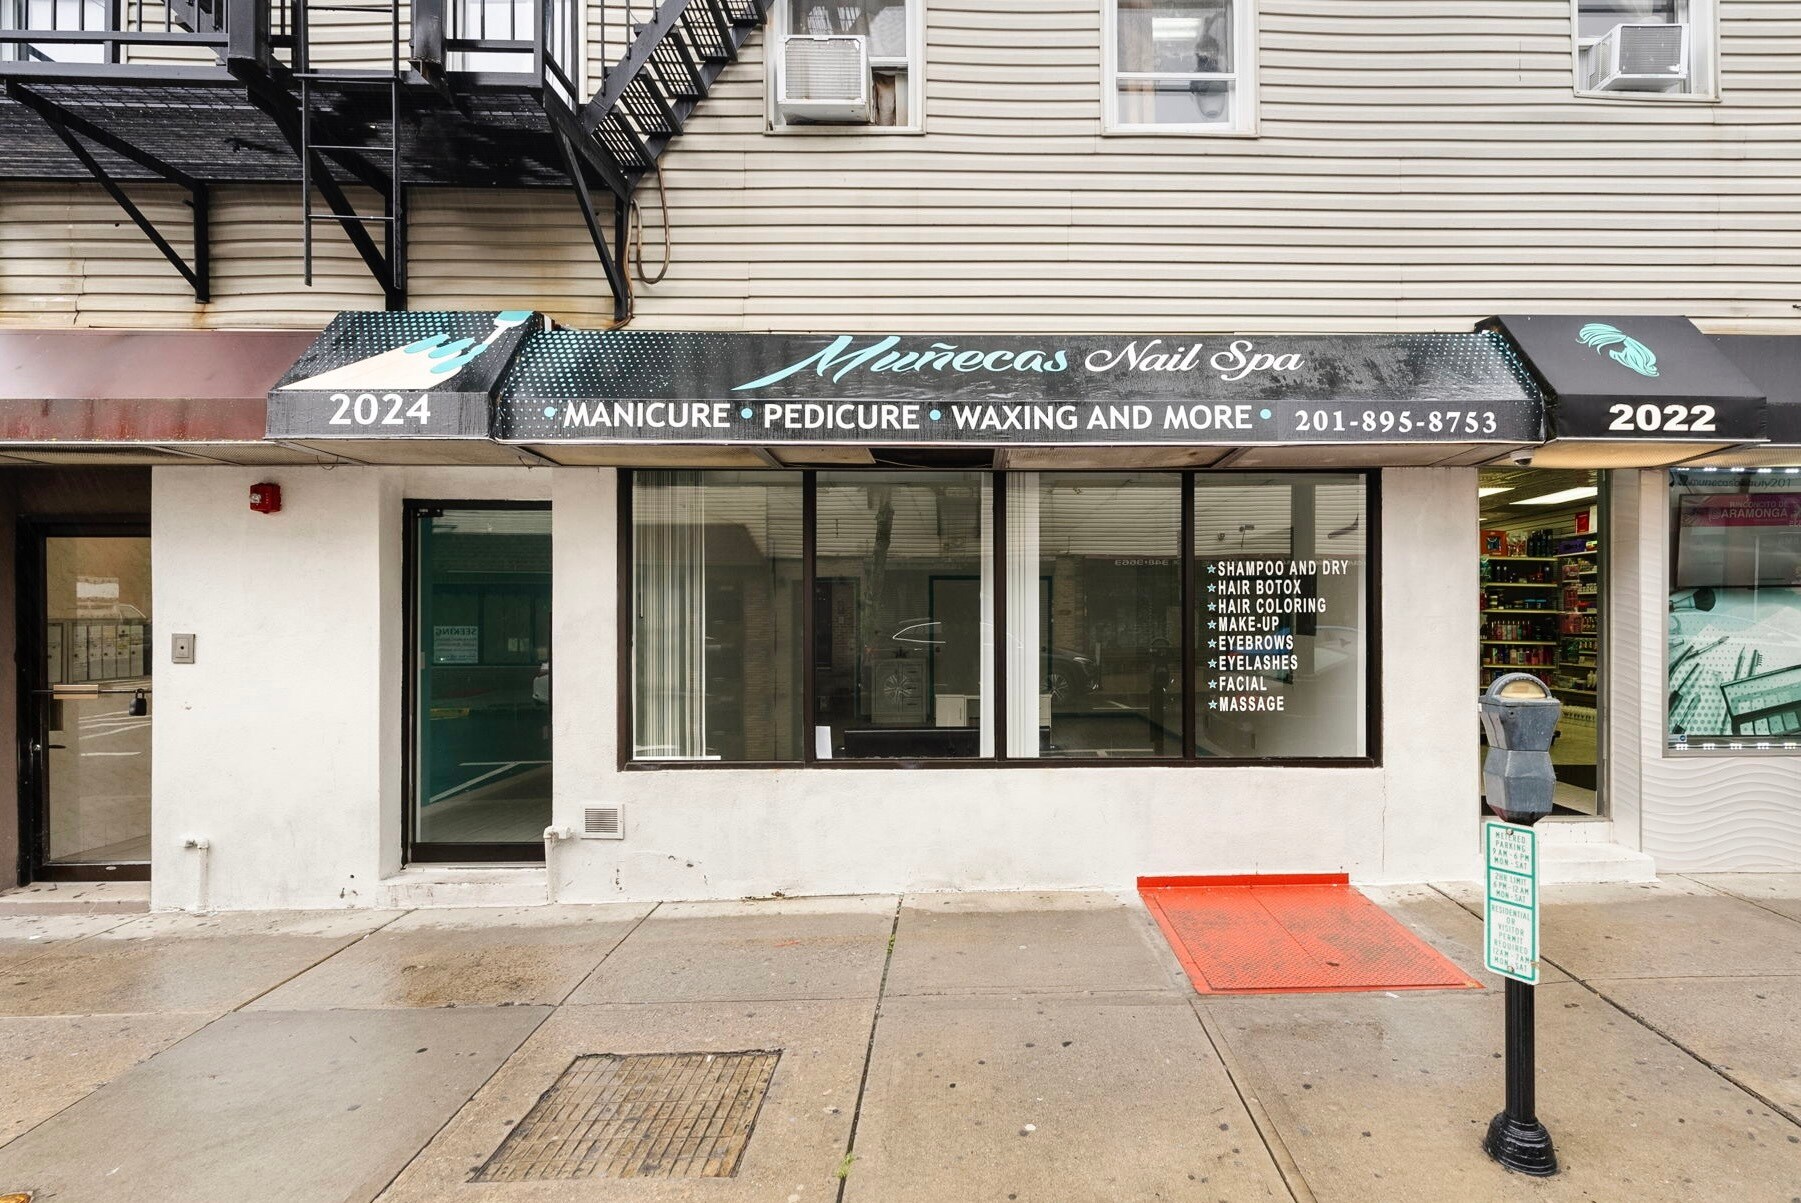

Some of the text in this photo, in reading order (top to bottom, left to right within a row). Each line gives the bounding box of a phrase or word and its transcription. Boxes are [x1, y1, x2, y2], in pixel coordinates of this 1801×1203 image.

[731, 335, 1306, 391] Muñecas Nail Spa
[329, 393, 432, 426] 2024
[1608, 403, 1717, 432] 2022
[563, 402, 1499, 434] MANICURE PEDICURE WAXING AND MORE 201-895-8753
[1218, 560, 1284, 576] SHAMPOO
[1289, 560, 1317, 575] AND
[1322, 560, 1349, 575] DRY
[1218, 579, 1302, 595] HAIR BOTOX
[1218, 598, 1327, 614] HAIR COLORING
[1218, 616, 1280, 632] MAKE-UP
[1218, 635, 1294, 651] EYEBROWS
[1219, 655, 1298, 671] EYELASHES
[1219, 676, 1268, 692] FACIAL
[1219, 696, 1285, 712] MASSAGE
[1495, 831, 1526, 844] METERED
[1495, 840, 1526, 853] PARKING
[1494, 857, 1509, 865] MON
[1515, 861, 1527, 870] SAT
[1499, 849, 1508, 857] AM
[1520, 853, 1530, 862] PM
[1509, 876, 1527, 887] LIMIT
[1496, 889, 1510, 899] MON
[1515, 894, 1526, 903] SAT
[1491, 904, 1530, 920] RESIDENTIAL
[1506, 916, 1516, 925] OR
[1498, 922, 1525, 937] VISITOR
[1499, 931, 1524, 945] PERMIT
[1493, 938, 1529, 955] REQUIRED
[1495, 956, 1527, 972] MON SAT
